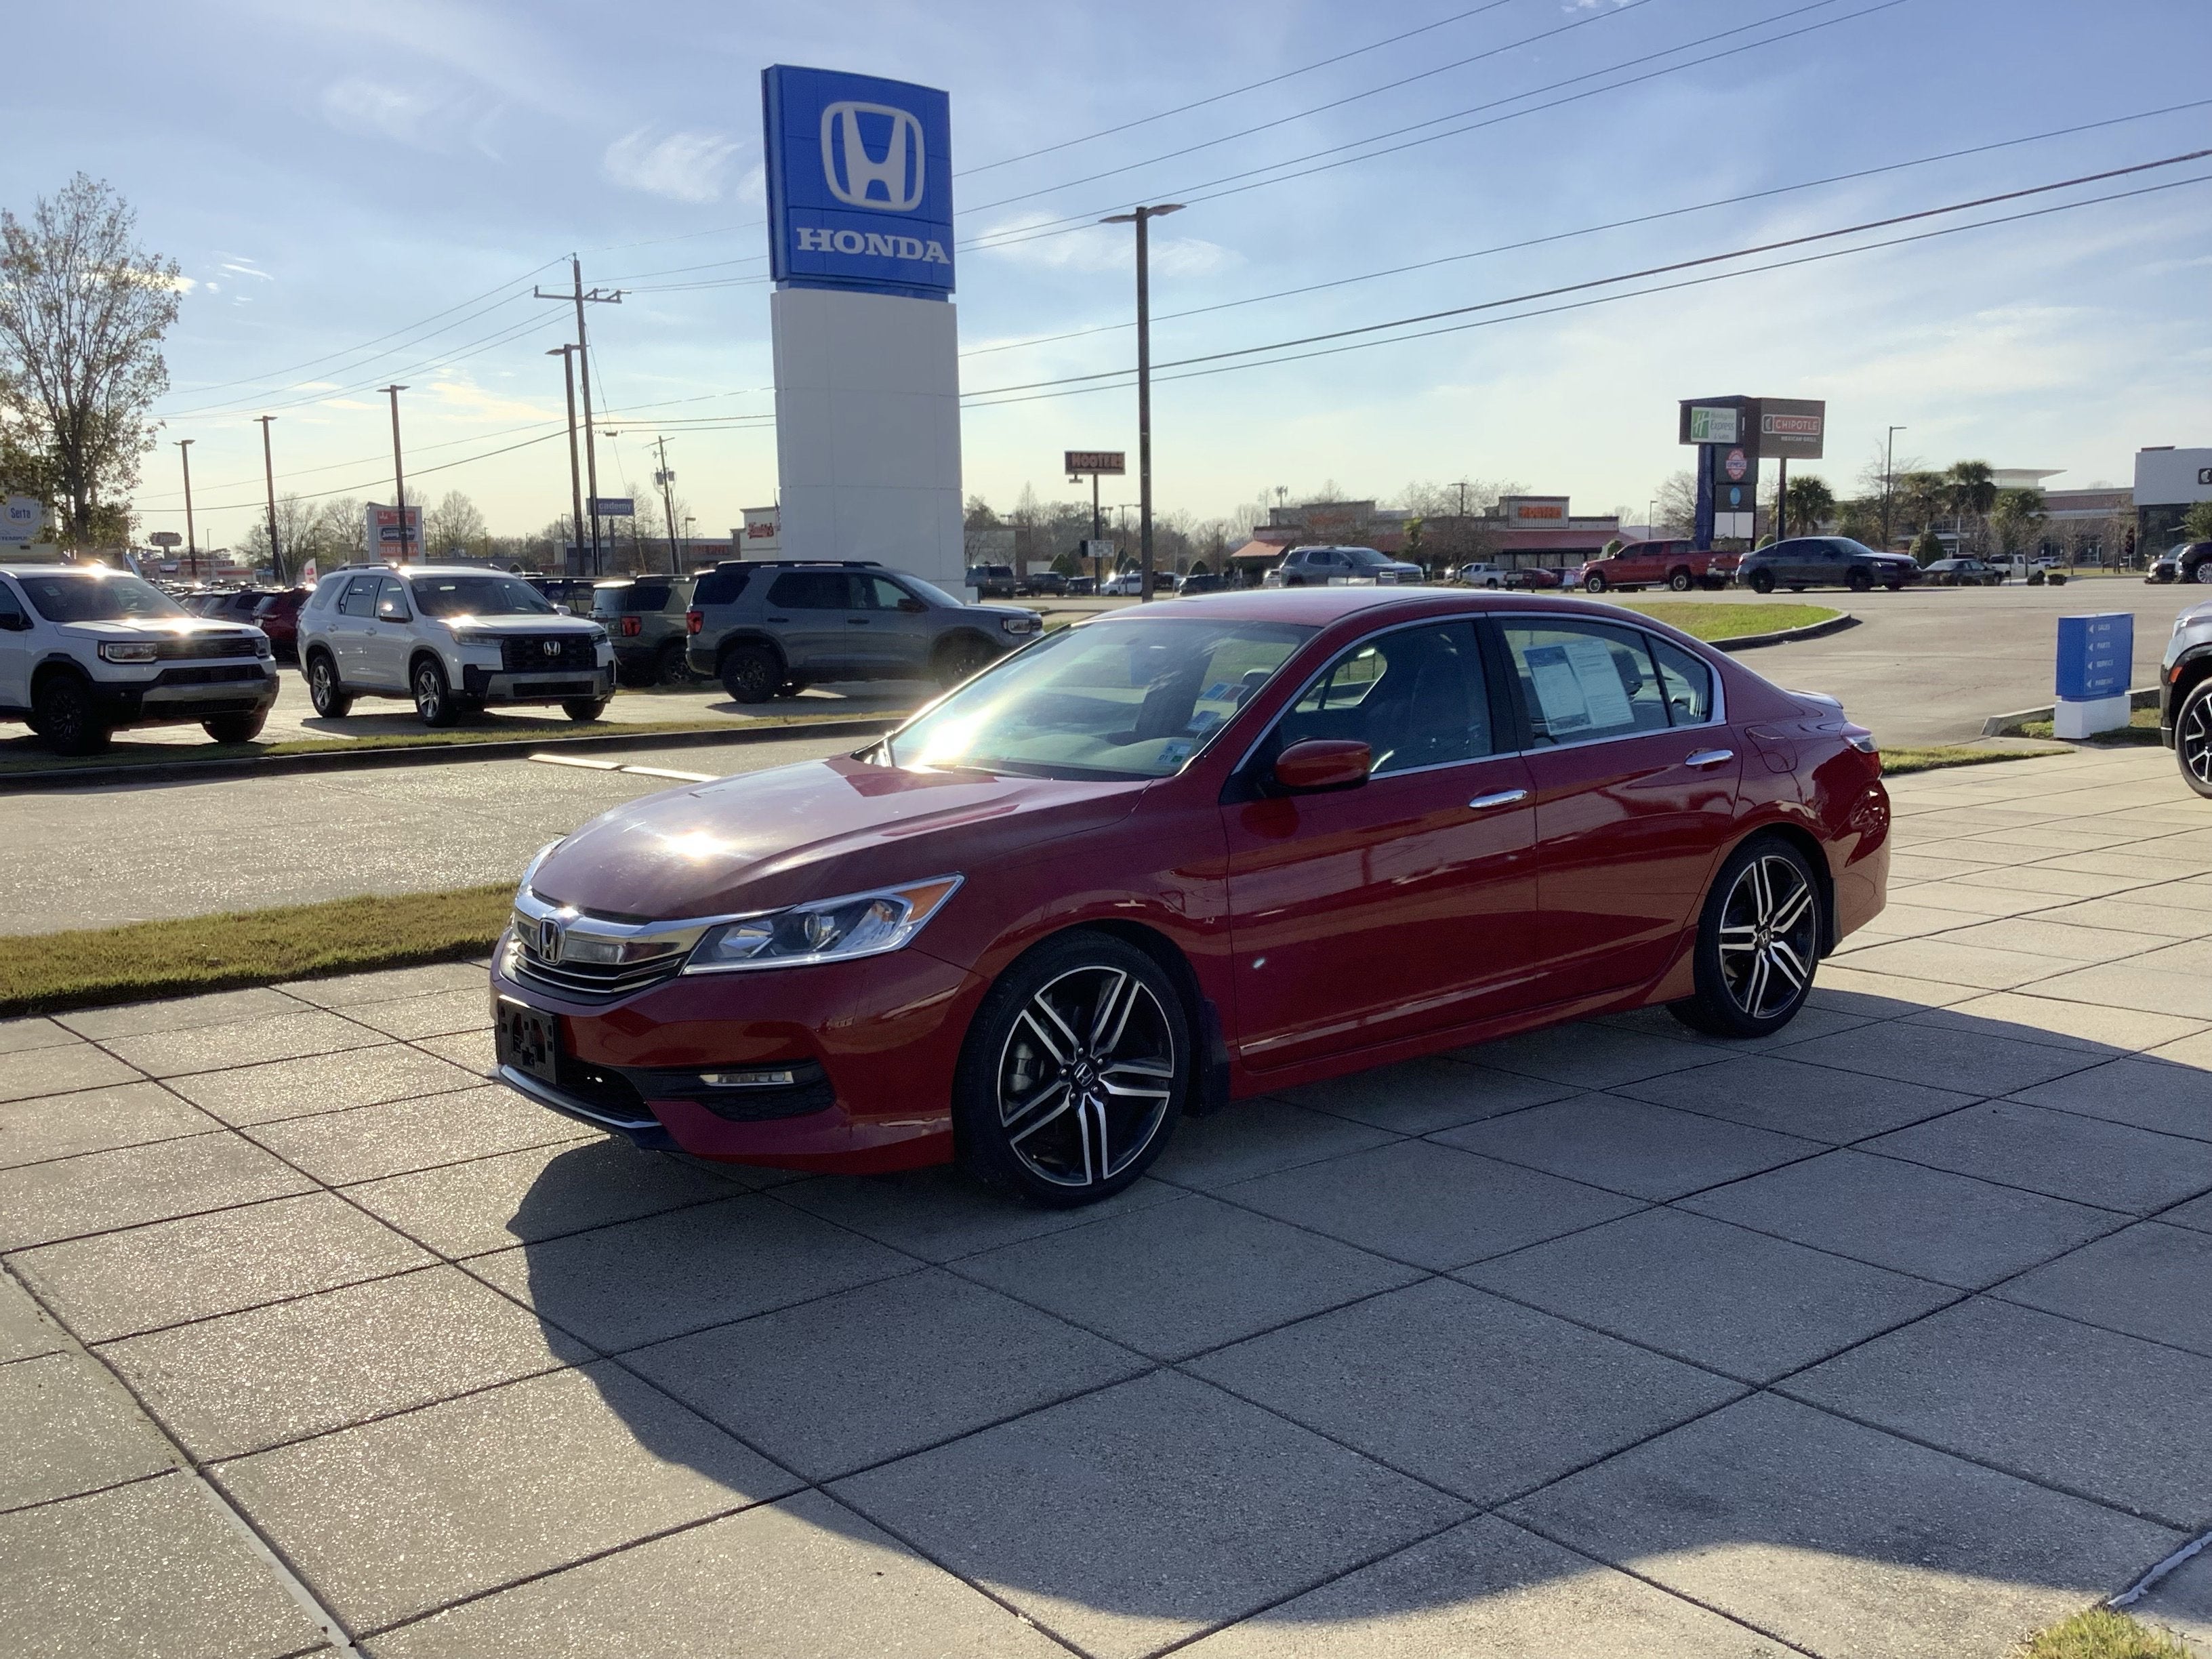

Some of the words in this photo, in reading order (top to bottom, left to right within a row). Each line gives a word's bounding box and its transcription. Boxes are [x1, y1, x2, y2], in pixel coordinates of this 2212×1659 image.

[796, 227, 950, 264] HONDA
[1711, 419, 1735, 430] Express
[1776, 419, 1818, 430] CHIPOTLE
[10, 507, 31, 519] Serta
